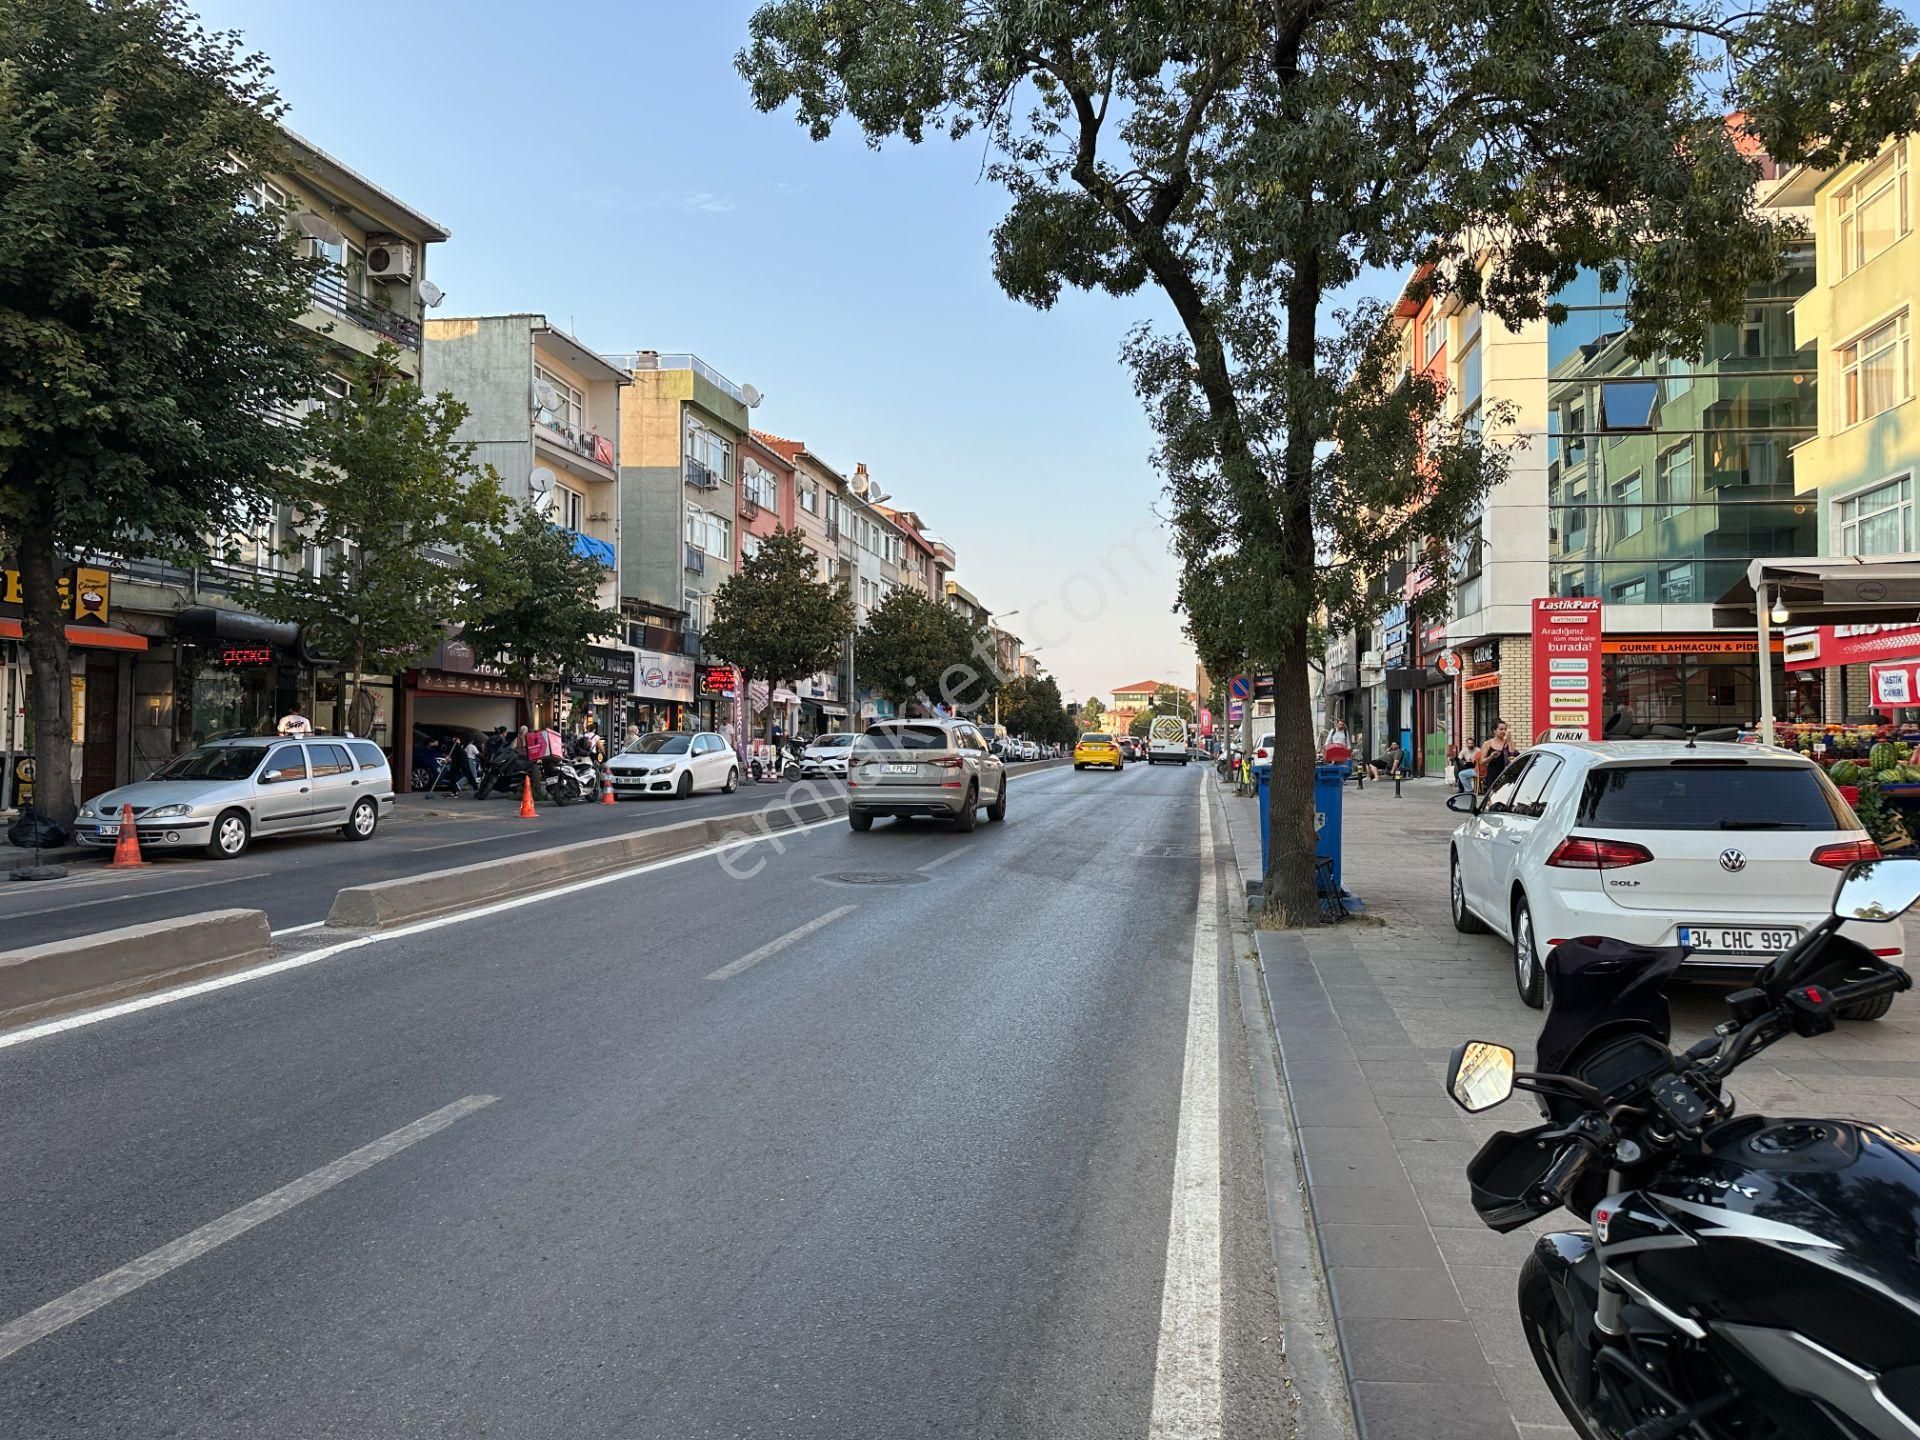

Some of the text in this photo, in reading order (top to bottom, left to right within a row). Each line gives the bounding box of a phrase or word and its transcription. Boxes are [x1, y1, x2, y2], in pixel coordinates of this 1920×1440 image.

[1538, 599, 1600, 610] LastikPark
[1541, 627, 1584, 637] Aradığınız
[1548, 641, 1592, 652] burada!
[1619, 644, 1658, 652] GURME
[1660, 643, 1721, 651] LAHMACUN
[1690, 930, 1712, 948] 34
[1721, 931, 1753, 949] CHC
[1761, 932, 1793, 949] 992
